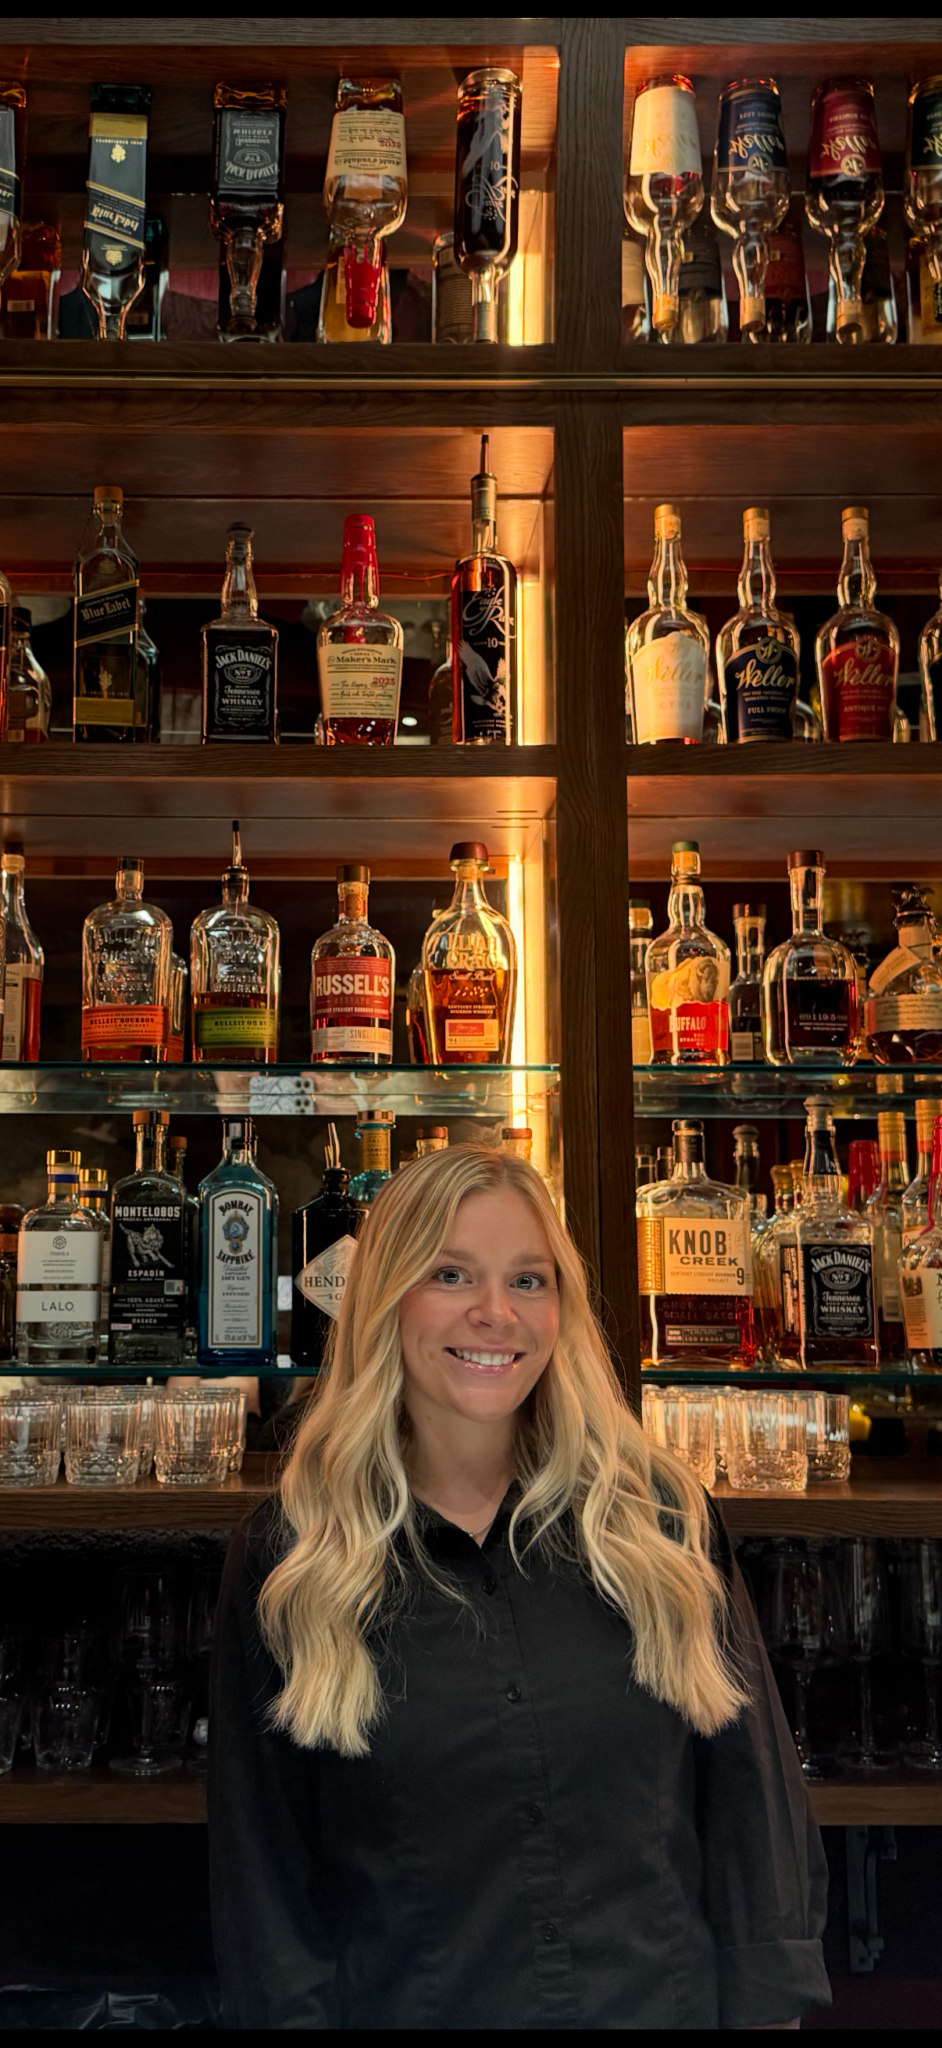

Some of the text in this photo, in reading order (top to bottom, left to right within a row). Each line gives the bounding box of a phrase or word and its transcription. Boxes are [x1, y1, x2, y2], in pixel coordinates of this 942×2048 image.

[81, 607, 105, 621] Blue
[104, 598, 131, 614] Label
[487, 637, 499, 648] 10
[215, 649, 272, 670] JACK DANIEL'S
[646, 655, 702, 684] Weller
[735, 658, 795, 690] Weller
[833, 657, 894, 688] Weller
[224, 685, 261, 695] Tennessee
[222, 698, 263, 706] WHISKEY
[747, 706, 765, 714] FULL
[843, 705, 876, 713] ANTIQUE
[446, 931, 497, 950] ELIJAH
[316, 974, 389, 997] RUSSELL'S
[90, 1017, 117, 1025] BULLEIT
[669, 1015, 707, 1032] BUFFALO
[349, 1029, 374, 1039] SINGL
[114, 1206, 180, 1218] MONTELOBOS
[218, 1200, 254, 1214] BOMBAY
[669, 1229, 727, 1255] KNOB
[216, 1249, 255, 1264] SAPPHIRE
[680, 1256, 739, 1266] CREEK
[811, 1251, 871, 1274] JACK DANIEL'S
[128, 1269, 165, 1277] ESPADÍN
[736, 1267, 745, 1285] 9
[822, 1291, 861, 1302] Tennessee
[41, 1301, 74, 1311] LALO
[820, 1305, 865, 1313] WHISKEY
